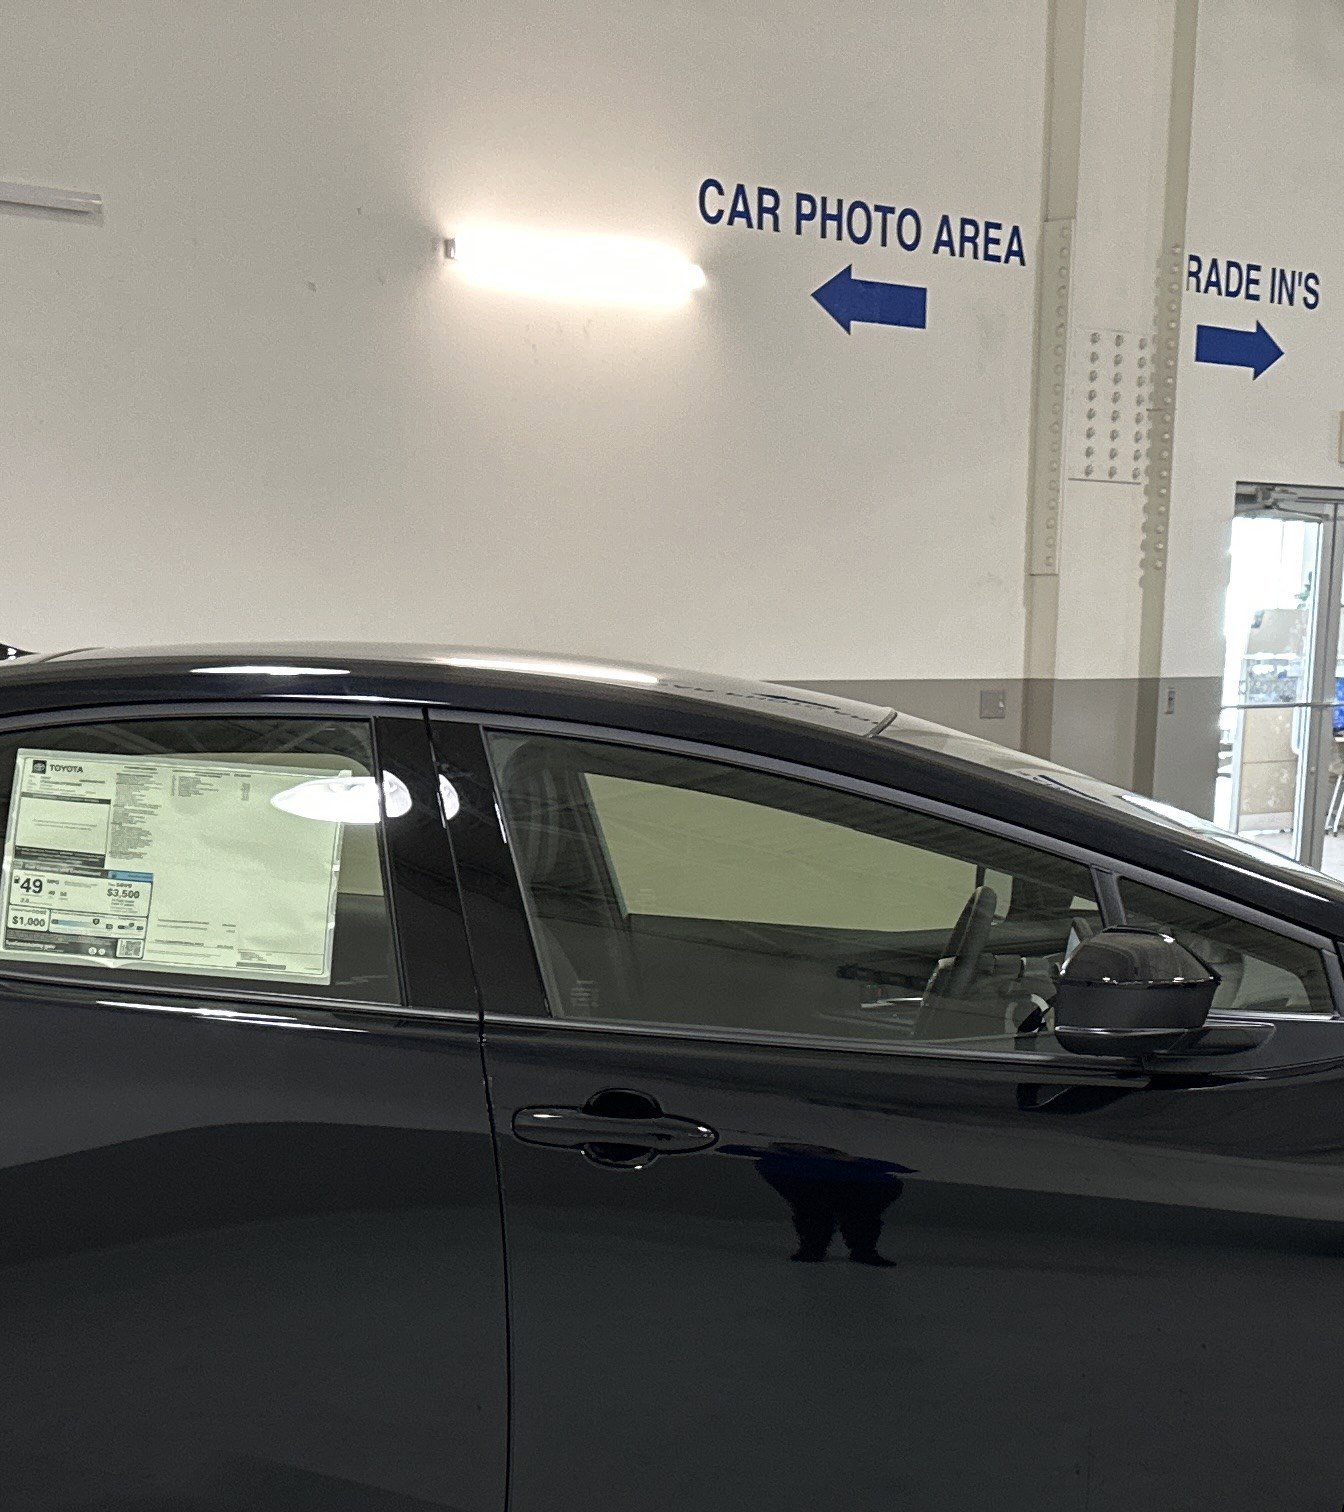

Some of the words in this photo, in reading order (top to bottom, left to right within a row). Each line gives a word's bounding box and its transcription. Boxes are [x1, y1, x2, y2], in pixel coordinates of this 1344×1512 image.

[698, 178, 781, 233] CAR
[795, 191, 922, 252] PHOTO
[932, 214, 1027, 267] AREA
[1185, 253, 1262, 302] RADE
[1269, 267, 1321, 310] IN'S
[49, 764, 84, 773] TOYOTA
[19, 877, 43, 894] 49
[106, 887, 140, 899] $3,500
[11, 915, 46, 927] $1,000
